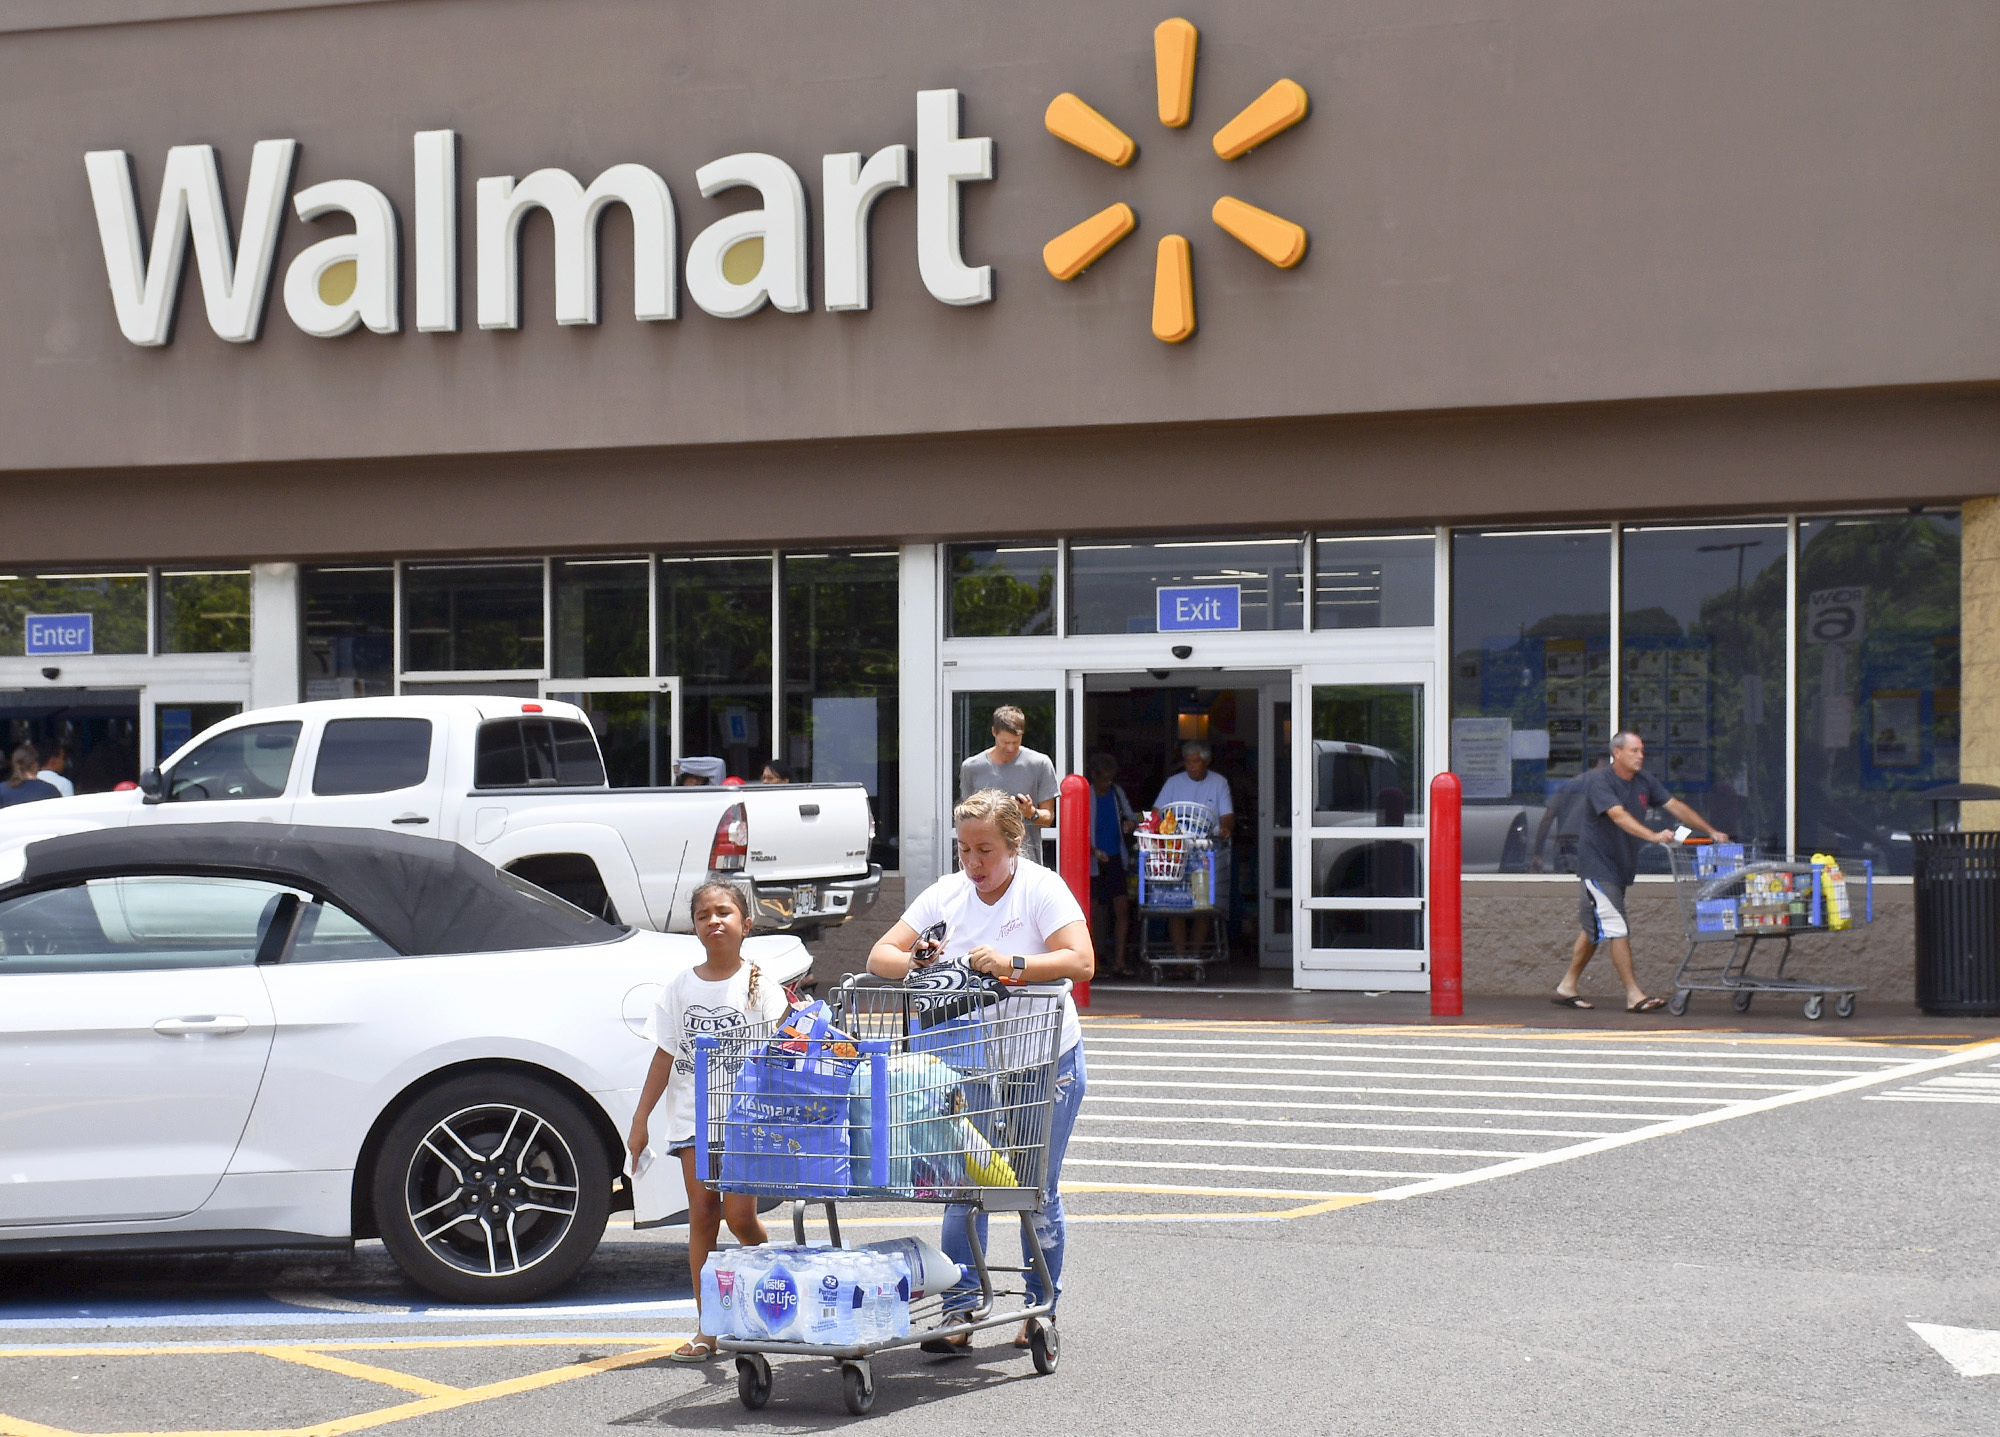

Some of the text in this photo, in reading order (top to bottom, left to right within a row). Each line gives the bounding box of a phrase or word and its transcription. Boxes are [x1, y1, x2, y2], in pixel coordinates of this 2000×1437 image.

[84, 88, 994, 347] Walmart
[1176, 596, 1221, 622] Exit
[32, 624, 86, 646] Enter
[825, 1276, 837, 1286] 32
[755, 1289, 797, 1310] Pure Life
